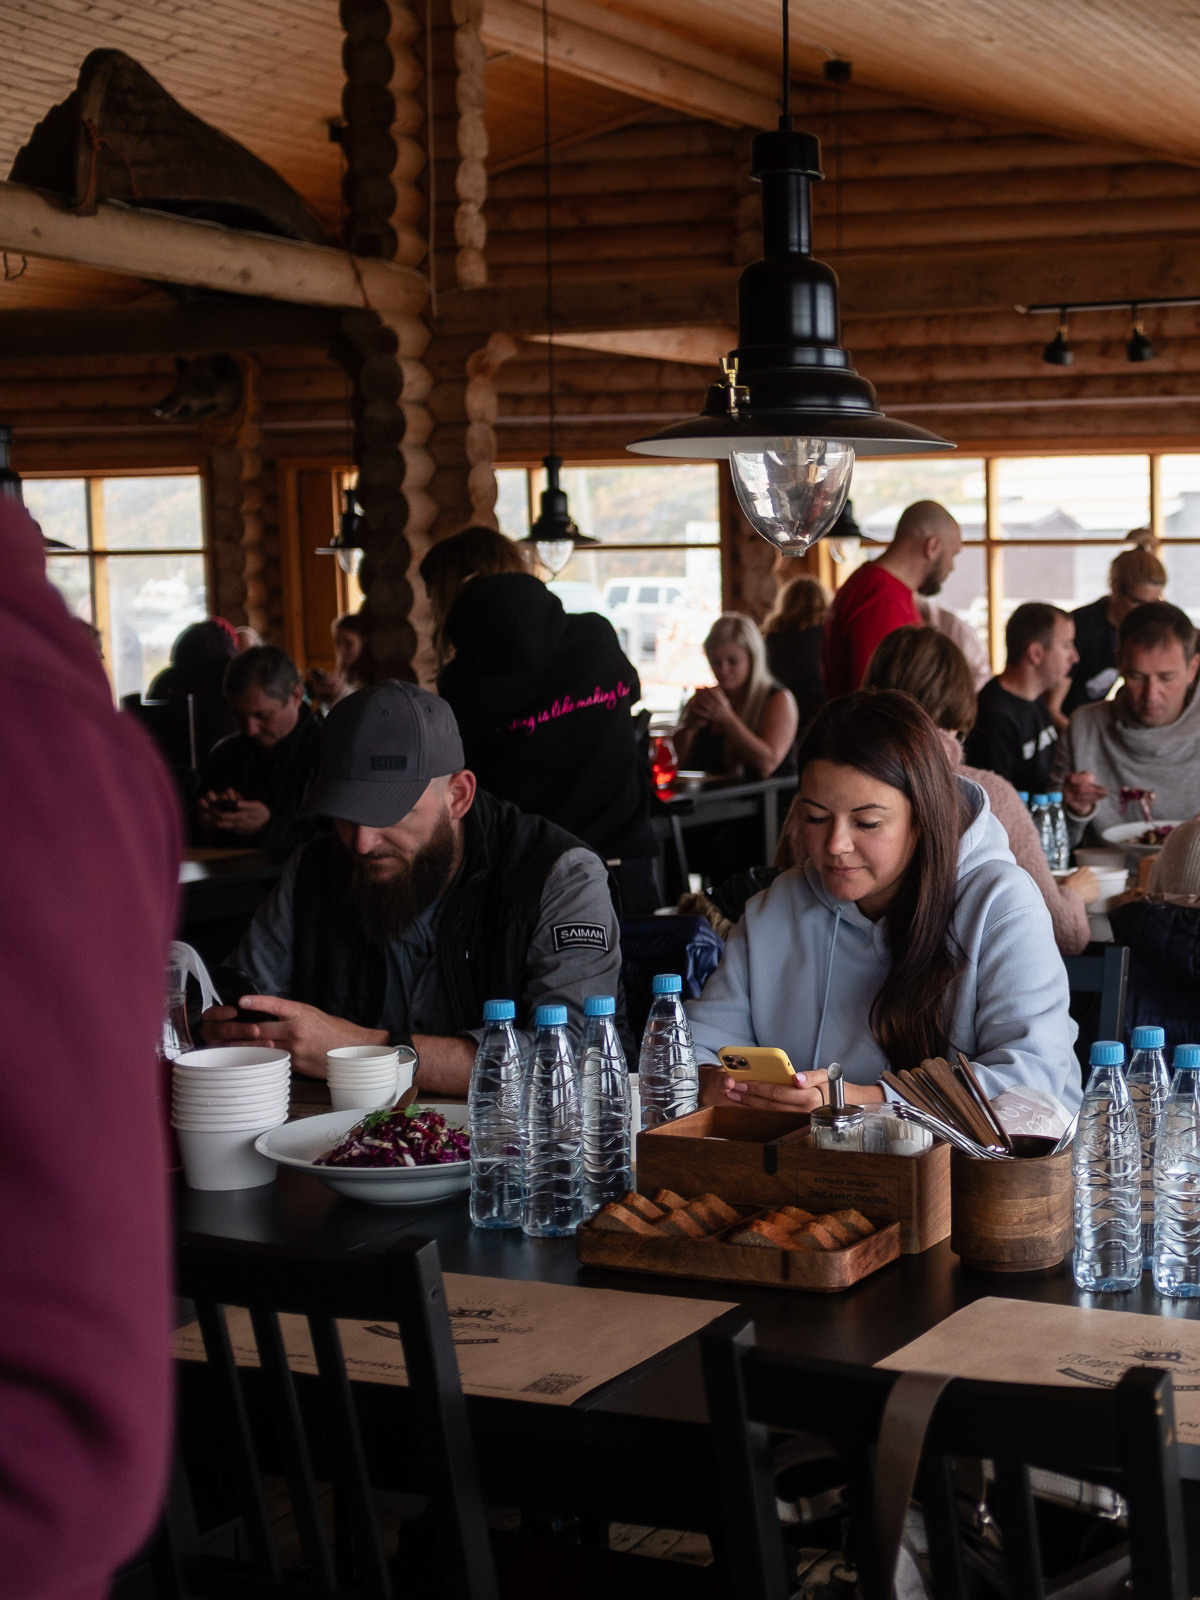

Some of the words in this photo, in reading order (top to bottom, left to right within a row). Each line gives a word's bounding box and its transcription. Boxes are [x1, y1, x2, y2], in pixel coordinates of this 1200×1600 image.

[551, 694, 575, 719] like
[576, 685, 617, 711] making
[561, 928, 604, 940] SAIMAN
[808, 1190, 853, 1202] ORGANIC
[854, 1193, 889, 1205] GOODS
